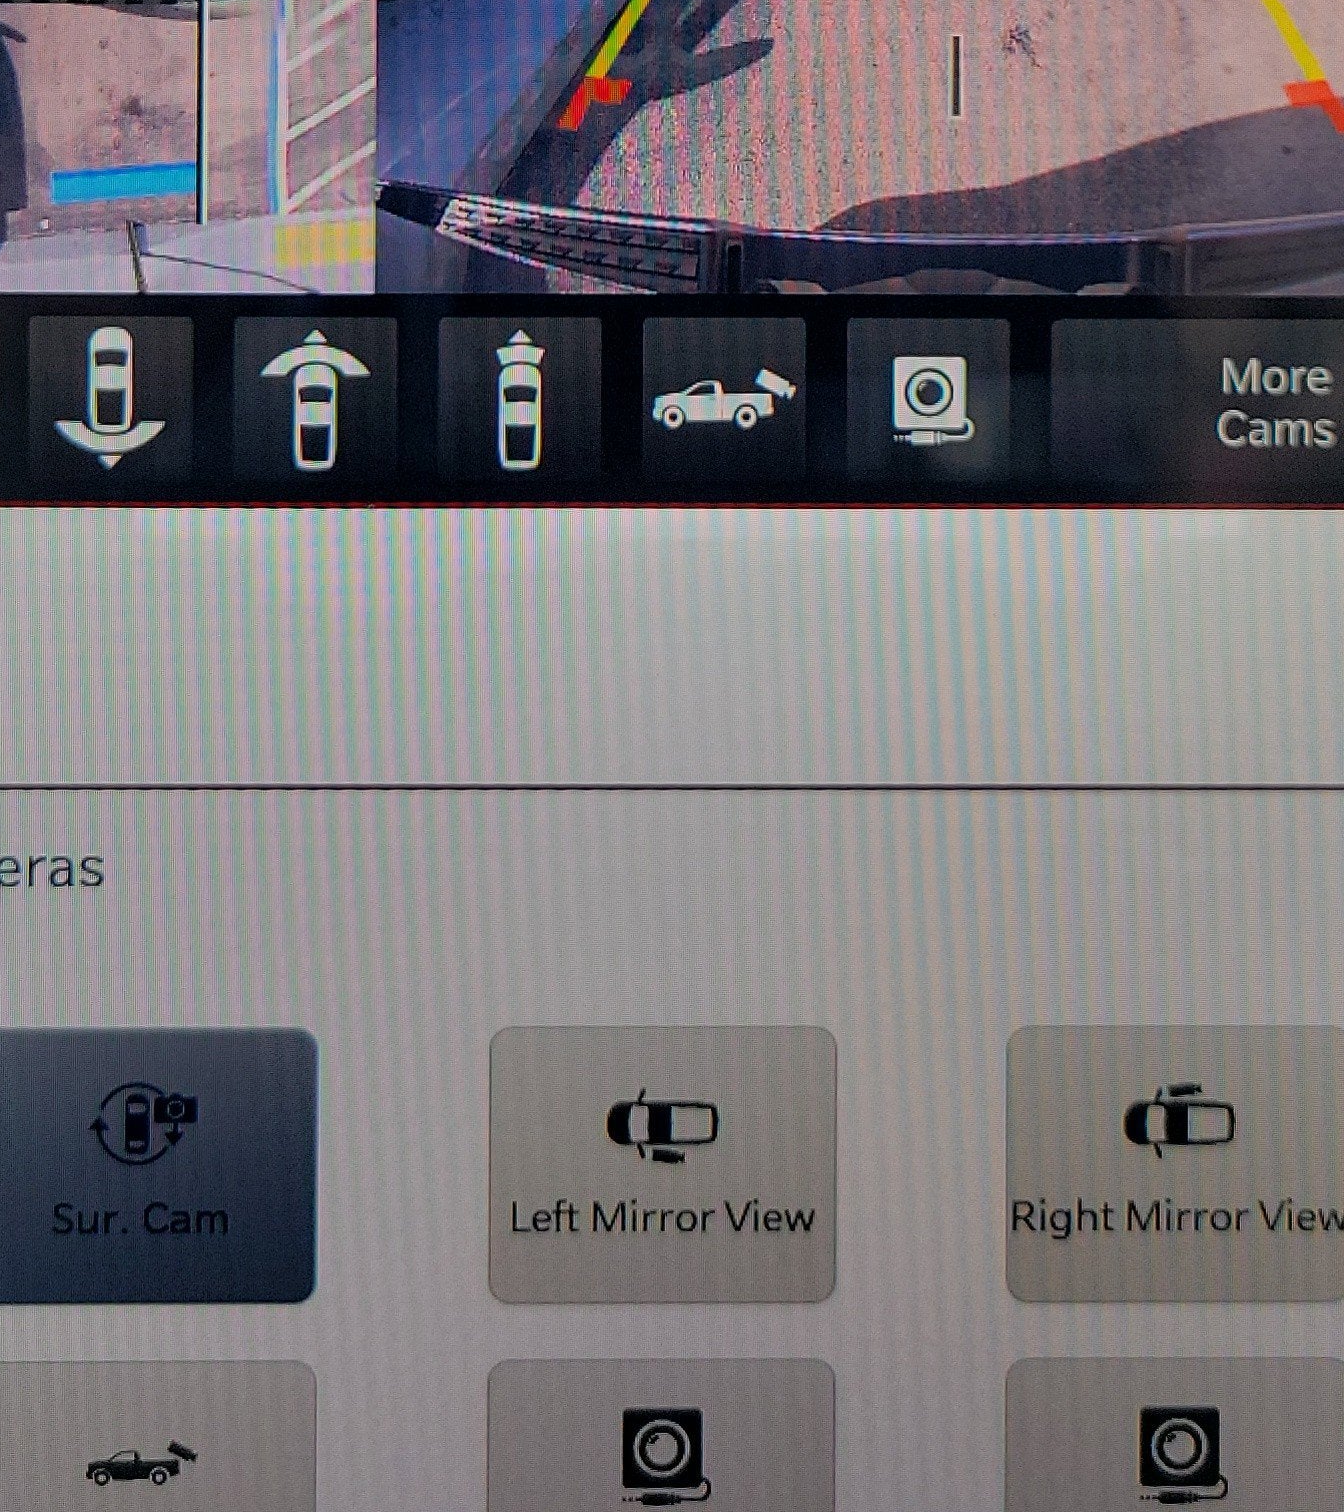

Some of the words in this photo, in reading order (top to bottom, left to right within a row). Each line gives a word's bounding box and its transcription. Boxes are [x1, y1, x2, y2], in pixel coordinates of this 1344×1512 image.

[1222, 357, 1333, 395] More
[1217, 409, 1336, 448] Cams
[51, 1202, 129, 1236] Sur.
[143, 1201, 229, 1236] Cam
[511, 1199, 579, 1233] Left
[592, 1201, 716, 1233] Mirror
[724, 1201, 816, 1233] View
[1011, 1198, 1114, 1241] Right
[1127, 1200, 1250, 1232] Mirror
